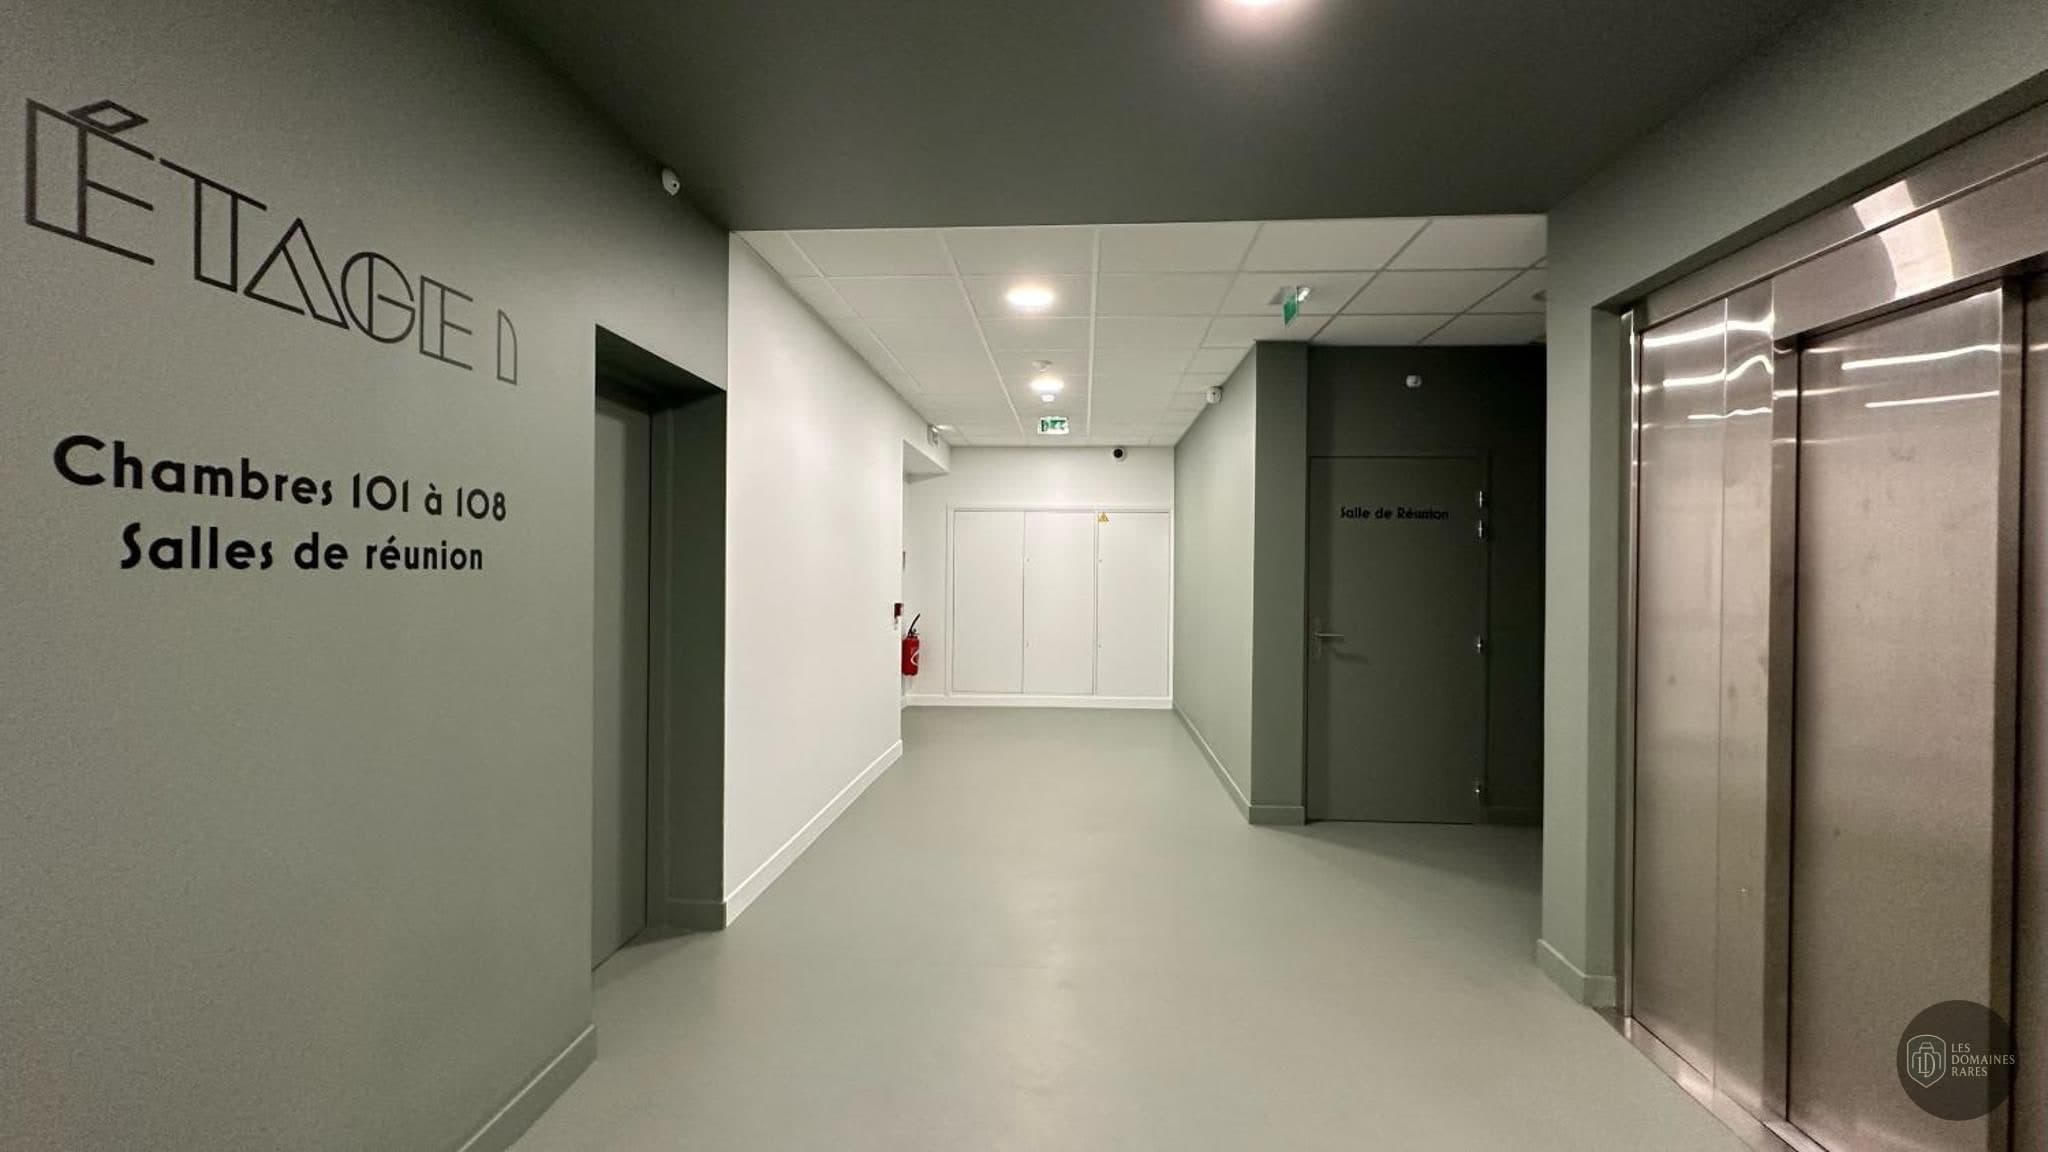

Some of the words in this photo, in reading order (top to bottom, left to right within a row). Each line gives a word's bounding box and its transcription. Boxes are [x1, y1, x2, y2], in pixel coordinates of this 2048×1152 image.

[53, 434, 333, 507] Chambres
[353, 472, 410, 514] 101
[425, 484, 442, 516] à
[457, 488, 507, 522] 108
[1340, 507, 1370, 520] Salle
[1375, 507, 1393, 520] de
[1397, 506, 1449, 521] Réunion
[120, 522, 273, 570] Salles
[294, 532, 348, 570] de
[366, 535, 483, 571] réunion
